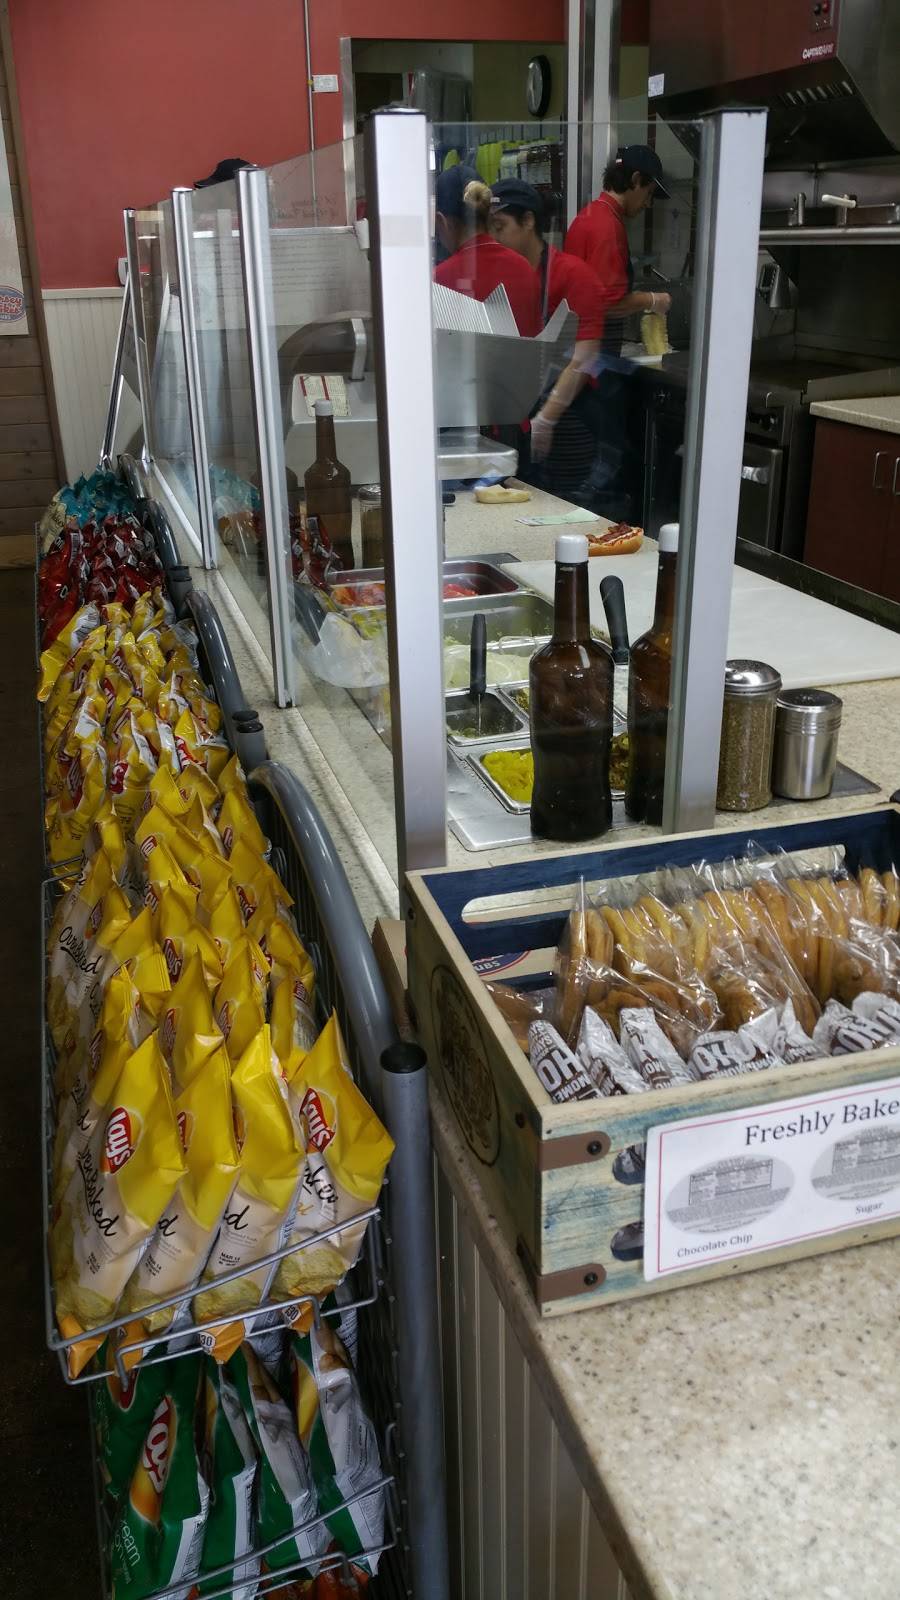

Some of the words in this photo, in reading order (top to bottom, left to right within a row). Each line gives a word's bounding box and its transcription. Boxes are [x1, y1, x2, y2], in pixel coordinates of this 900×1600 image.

[473, 960, 501, 972] UBS
[106, 1111, 131, 1166] Lay's
[745, 1111, 835, 1146] Freshly
[855, 1201, 884, 1215] Sugar
[677, 1239, 728, 1259] Chocolate
[730, 1233, 754, 1246] Chip
